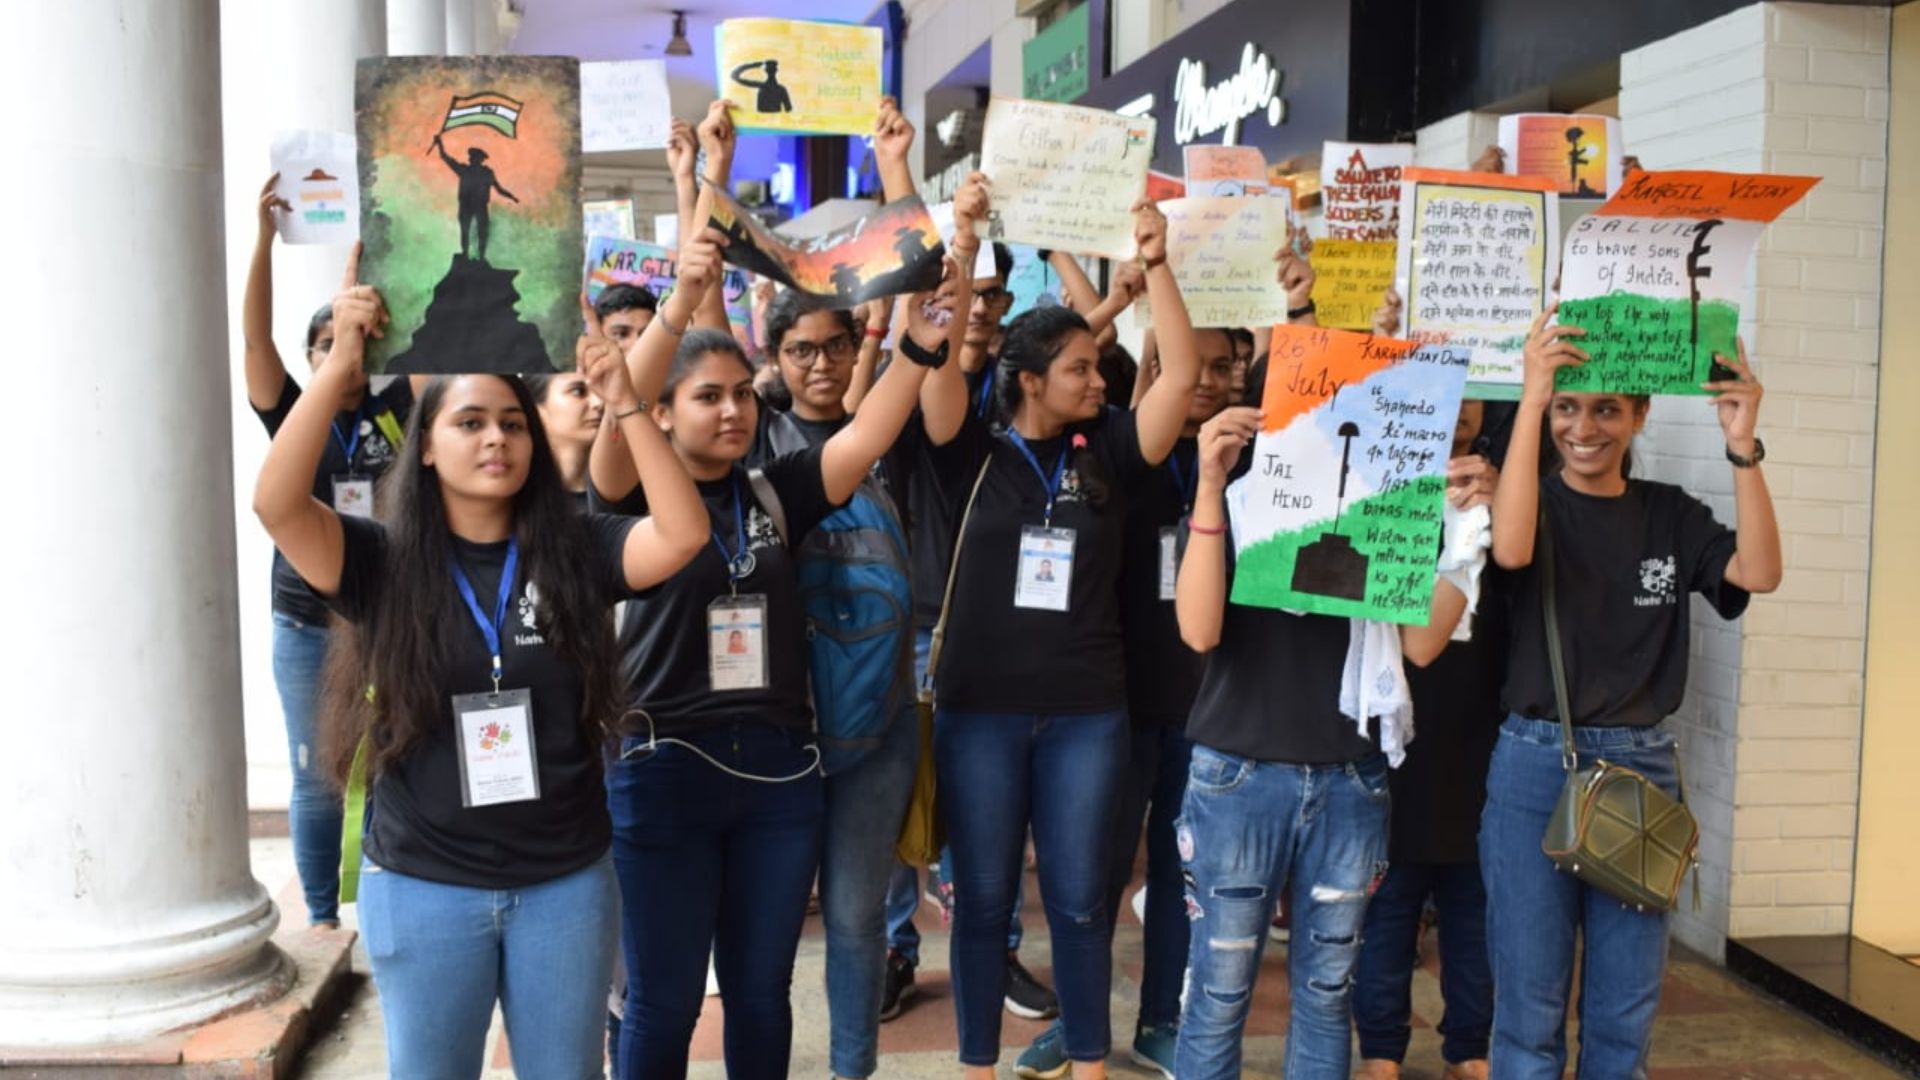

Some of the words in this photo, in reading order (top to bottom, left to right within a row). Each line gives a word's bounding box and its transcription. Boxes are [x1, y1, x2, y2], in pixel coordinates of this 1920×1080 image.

[1728, 178, 1793, 200] VIJAY
[1571, 239, 1589, 256] to
[1596, 239, 1637, 257] brave
[1287, 362, 1347, 412] July
[1262, 453, 1294, 480] JAI
[1271, 488, 1313, 510] HIND
